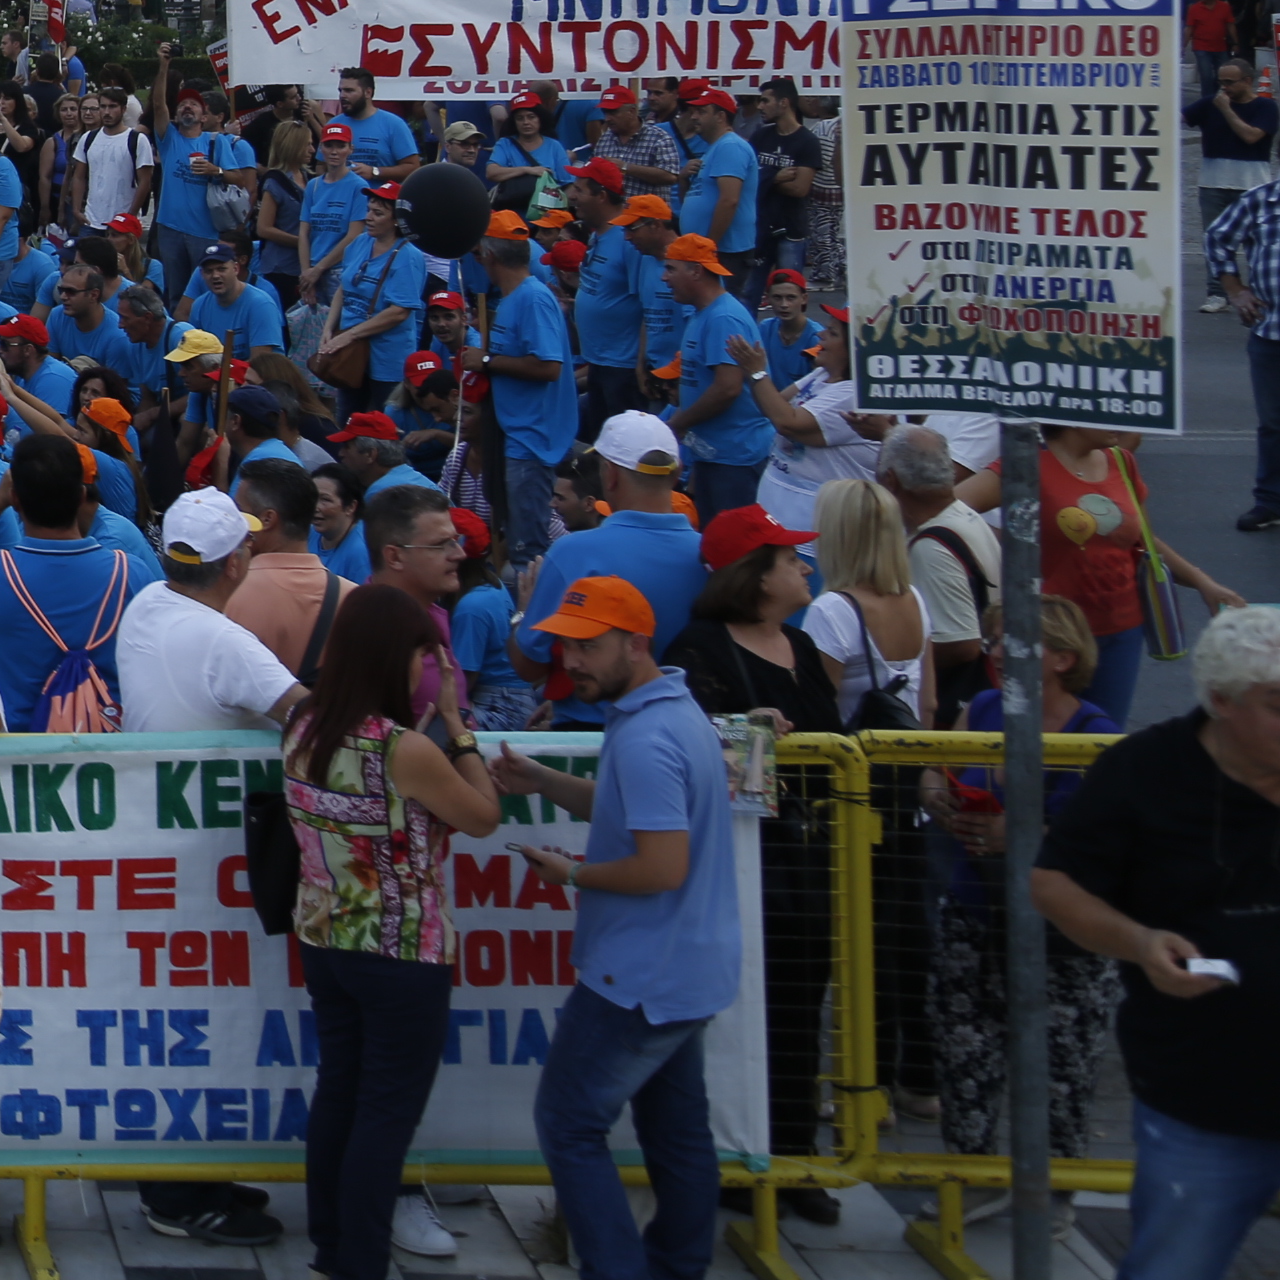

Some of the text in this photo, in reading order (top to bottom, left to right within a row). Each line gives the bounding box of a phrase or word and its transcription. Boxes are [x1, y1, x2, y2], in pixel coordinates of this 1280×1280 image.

[1096, 25, 1160, 59] ΔΕΘ
[857, 61, 963, 89] ΣΑΒΒΑΤΟ
[1070, 104, 1160, 137] ΣΤΙΣ
[860, 142, 1160, 192] ΑΥΤΑΠΑΤΕΣ
[874, 203, 1149, 239] ΒΑΖΟΥΜΕ ΤΕΛΟΣ
[921, 241, 970, 263] στα
[993, 274, 1116, 304] ΑΝΕΡΓΙΑ
[898, 304, 951, 328] στη
[866, 354, 1163, 395] ΘΕΣΣΑΛΟΝΙΚΗ
[868, 381, 956, 401] ΑΓΑΛΜΑ
[1097, 396, 1164, 418] 18:00
[128, 931, 250, 987] ΤΩΝ
[76, 1009, 210, 1067] ΤΗΣ
